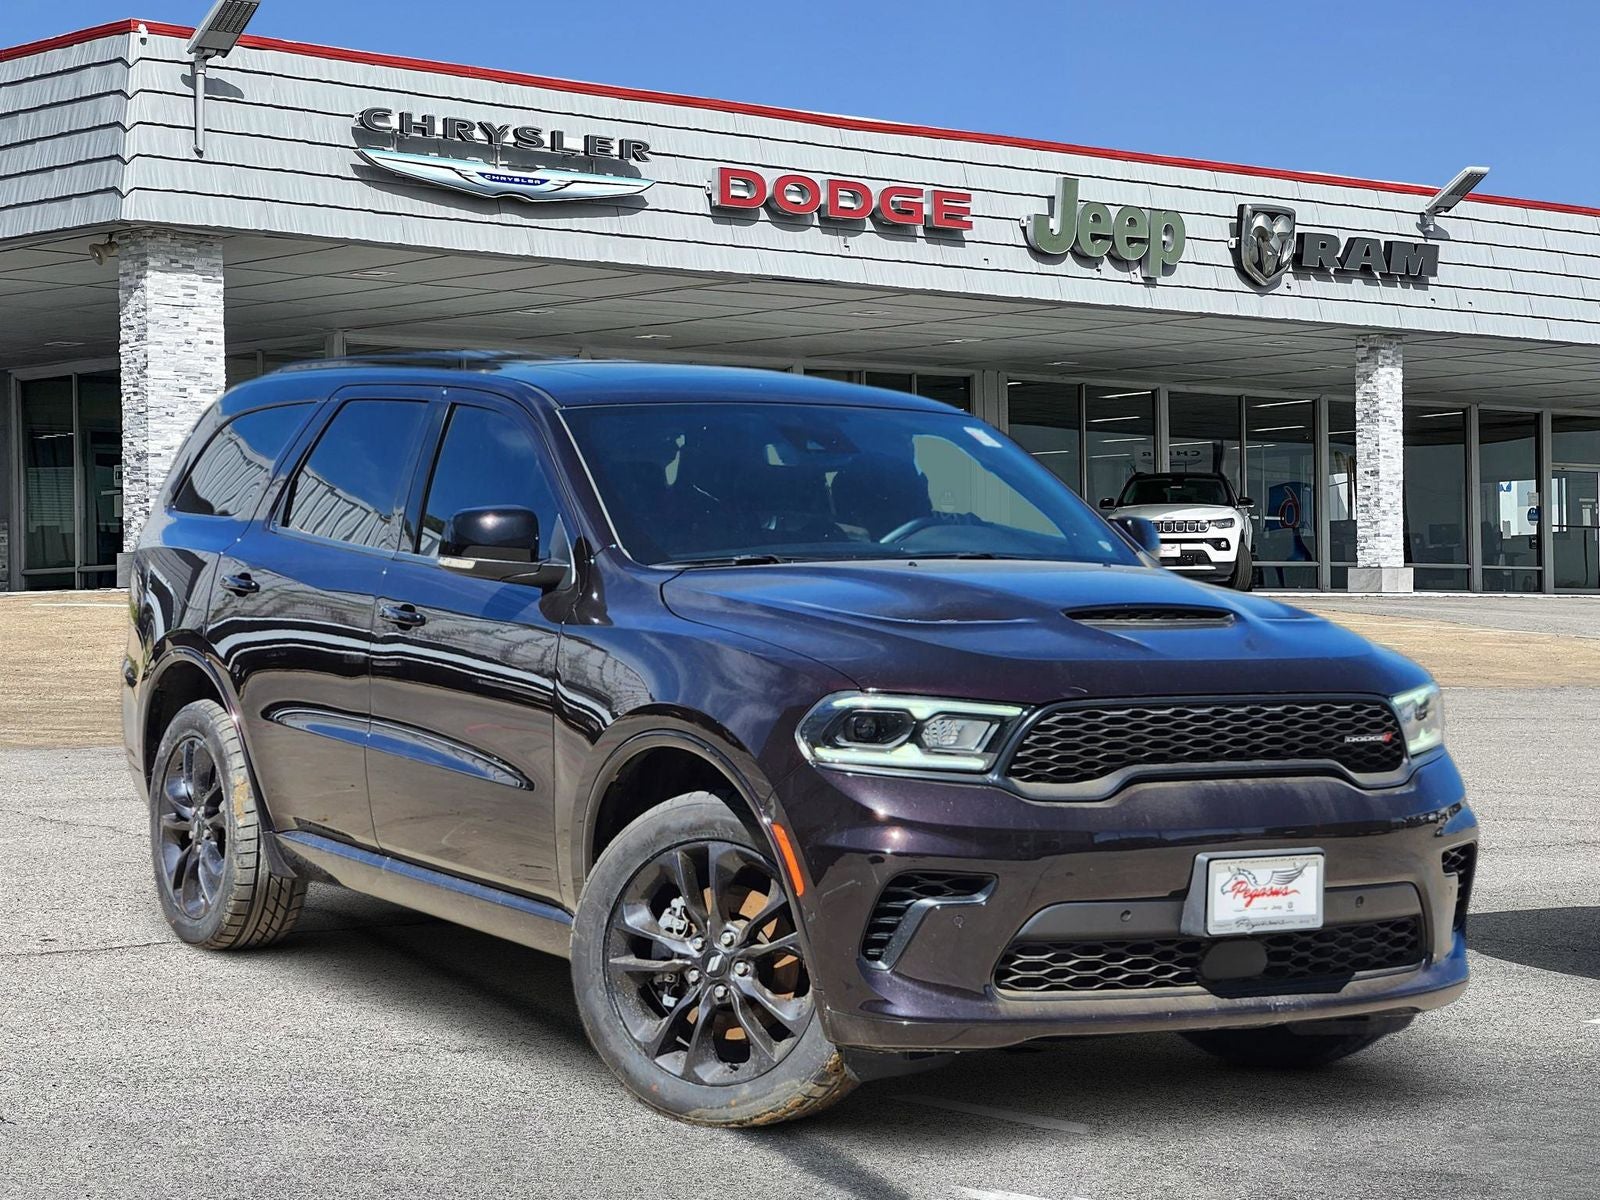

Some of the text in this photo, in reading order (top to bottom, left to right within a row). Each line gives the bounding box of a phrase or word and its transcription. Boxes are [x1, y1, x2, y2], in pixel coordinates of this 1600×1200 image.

[359, 107, 651, 162] CHRYSLER
[484, 174, 541, 185] CHRYSLER
[713, 167, 974, 230] DODGE
[1026, 177, 1186, 278] Jeep
[1297, 232, 1440, 277] RAM
[1231, 880, 1300, 907] Pegasus
